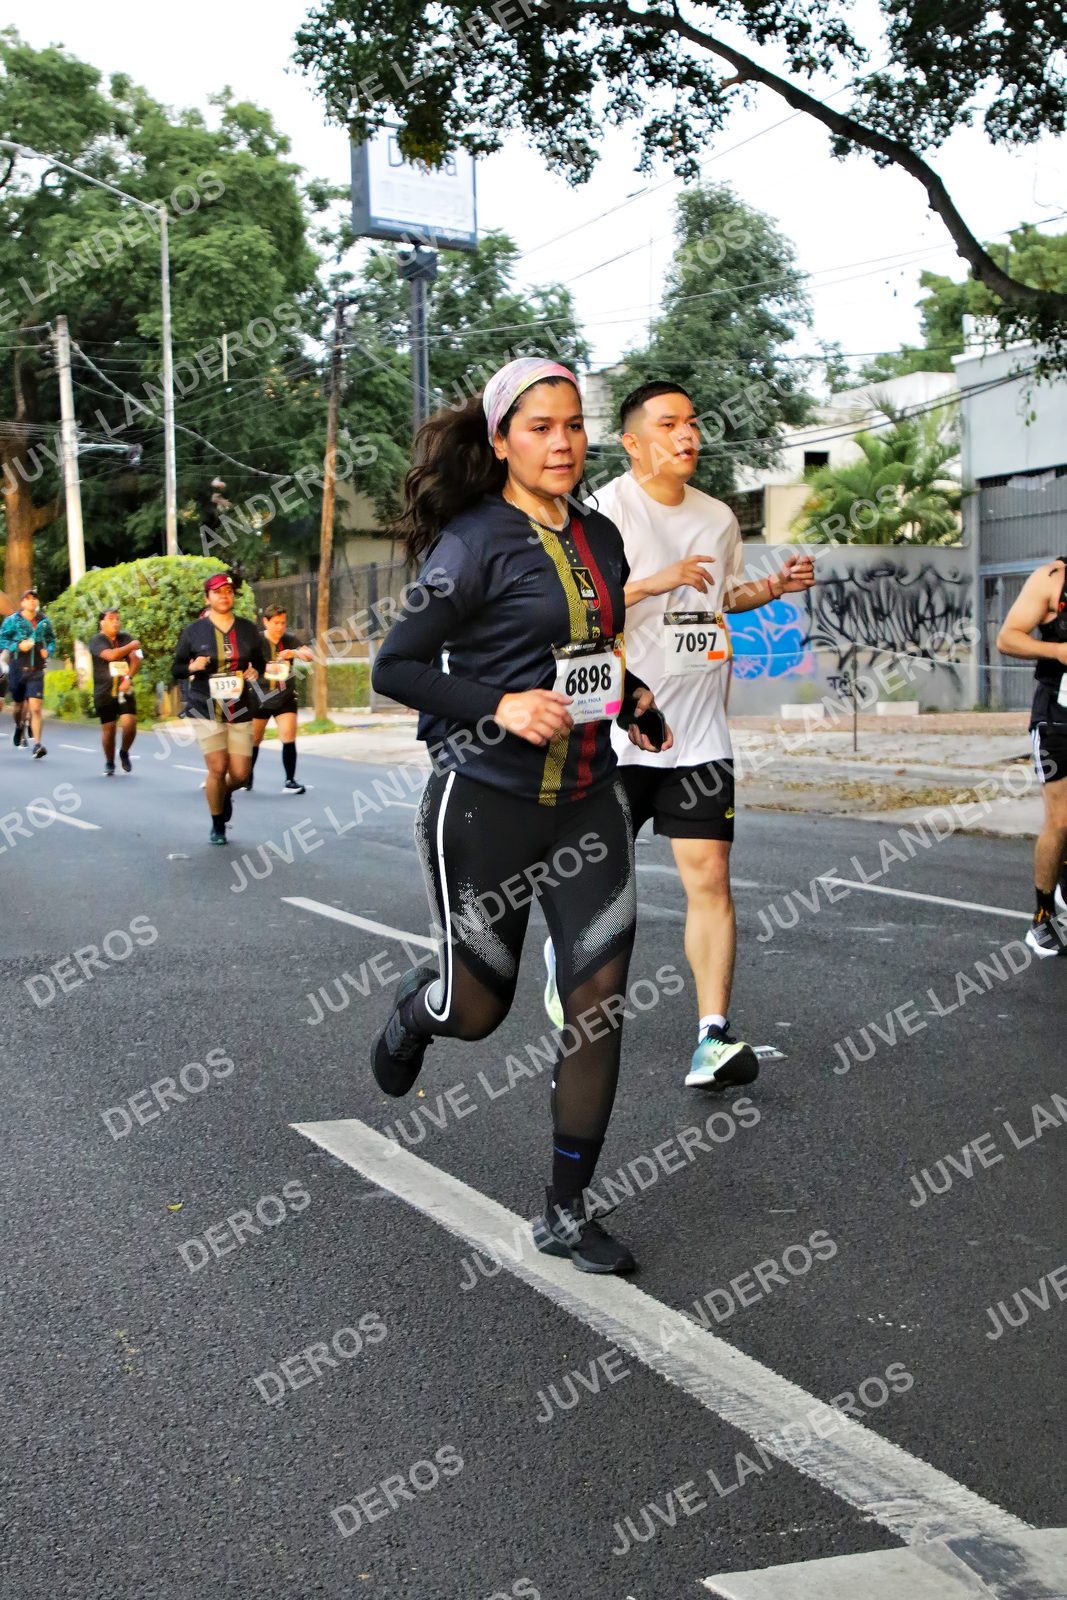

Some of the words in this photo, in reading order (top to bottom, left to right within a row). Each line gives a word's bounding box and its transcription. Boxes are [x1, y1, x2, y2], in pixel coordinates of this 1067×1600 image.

[675, 631, 717, 653] 7097
[215, 680, 237, 690] 1319
[565, 663, 612, 696] 6898
